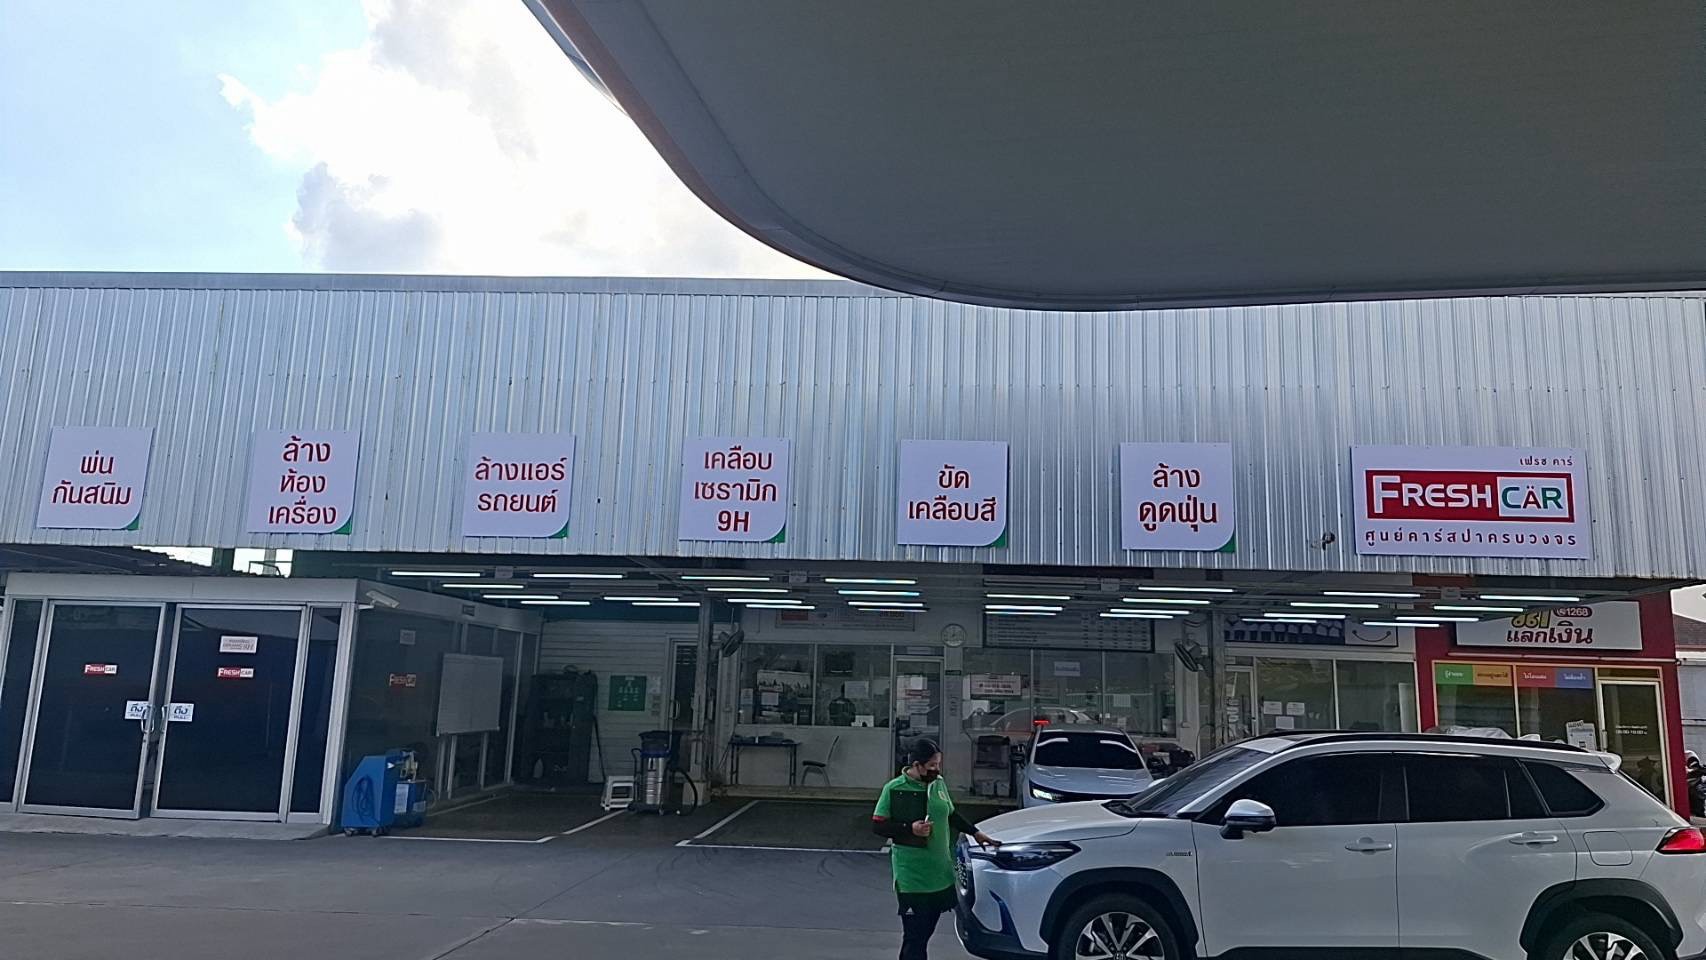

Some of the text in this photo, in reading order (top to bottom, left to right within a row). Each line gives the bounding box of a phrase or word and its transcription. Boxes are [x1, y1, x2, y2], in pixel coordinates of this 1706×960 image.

[282, 435, 331, 462] ล้าง
[704, 446, 773, 471] เคลือบ
[1552, 455, 1573, 466] คาร์
[80, 449, 114, 475] พ่น
[475, 456, 567, 481] ล้างแอร์
[280, 468, 326, 494] ท้อง
[938, 464, 970, 489] ขัด
[1153, 463, 1201, 488] ล้าง
[52, 479, 132, 505] กันสนิม
[477, 489, 558, 513] รถยนต์
[694, 478, 777, 502] เซรามิก
[1372, 475, 1493, 514] FRESH
[268, 497, 338, 525] เครื่อง
[908, 495, 997, 522] เคลือบสี
[1138, 497, 1218, 533] ดูดฝุ่น
[717, 510, 750, 533] 9H
[1365, 527, 1577, 547] ศูนย์คาร์สปาครบวงจร
[1566, 608, 1589, 617] 1268
[1506, 620, 1593, 643] แลกเงิน
